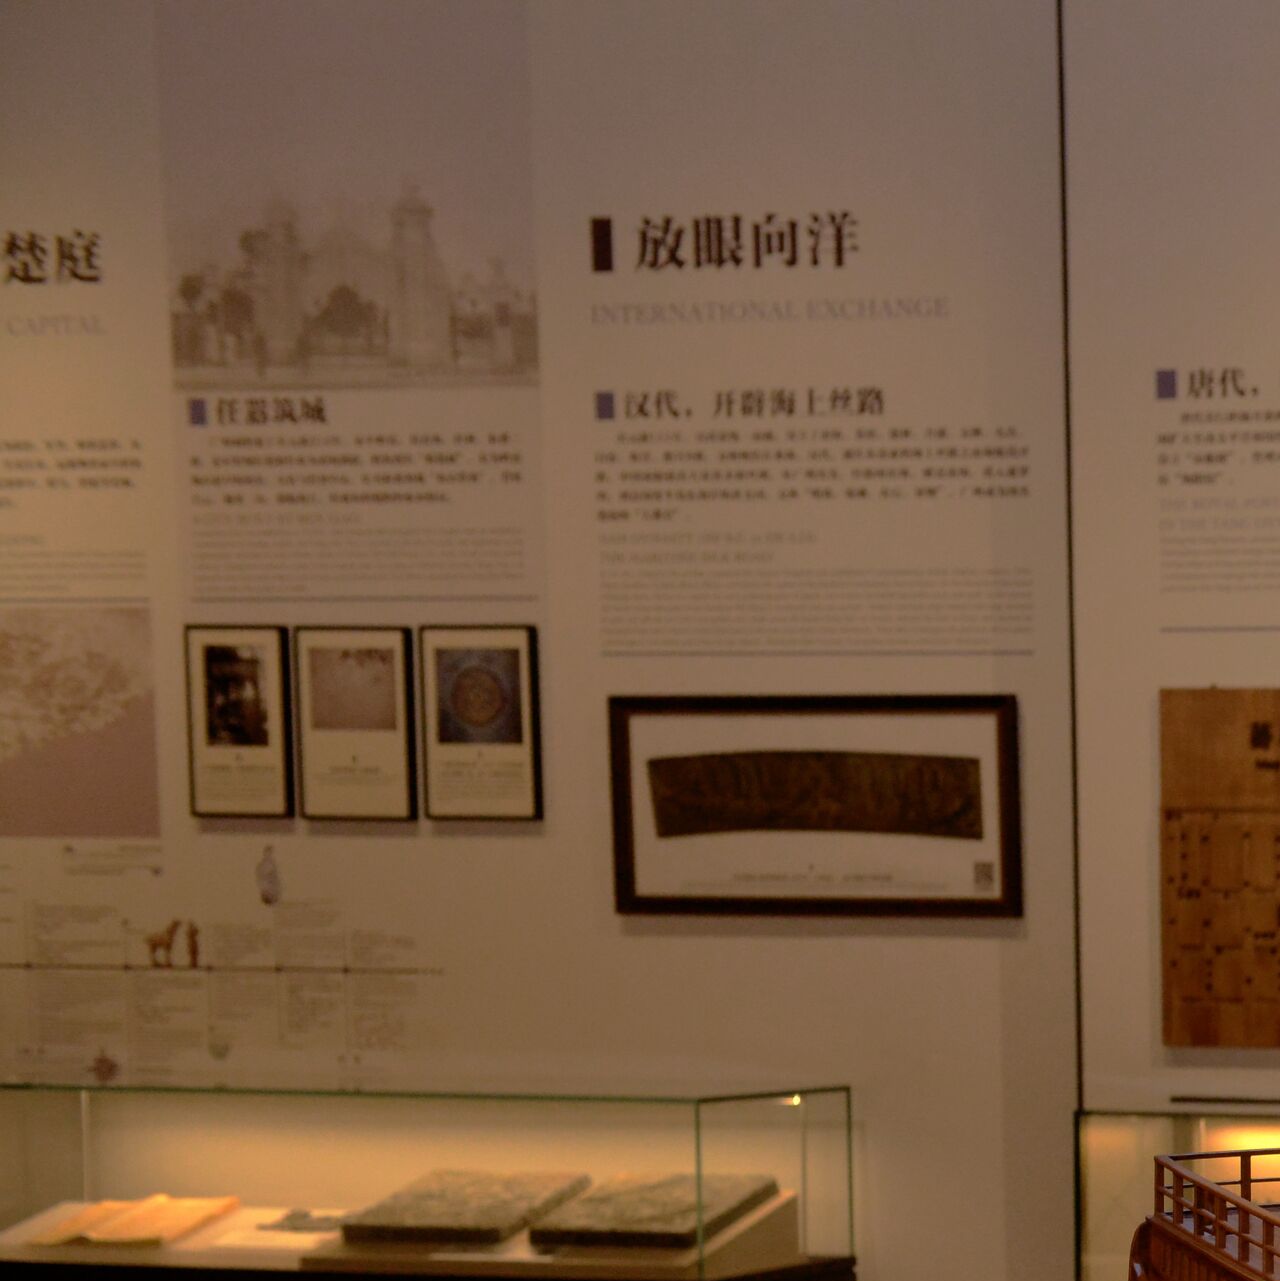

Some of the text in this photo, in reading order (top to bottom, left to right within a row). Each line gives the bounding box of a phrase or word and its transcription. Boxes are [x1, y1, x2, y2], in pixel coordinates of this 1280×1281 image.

[1, 231, 104, 285] 楚庭
[636, 210, 860, 272] 放眼向洋
[590, 297, 950, 326] INTERNATIONAL EXCHANGE
[216, 396, 329, 426] 任嚣筑城
